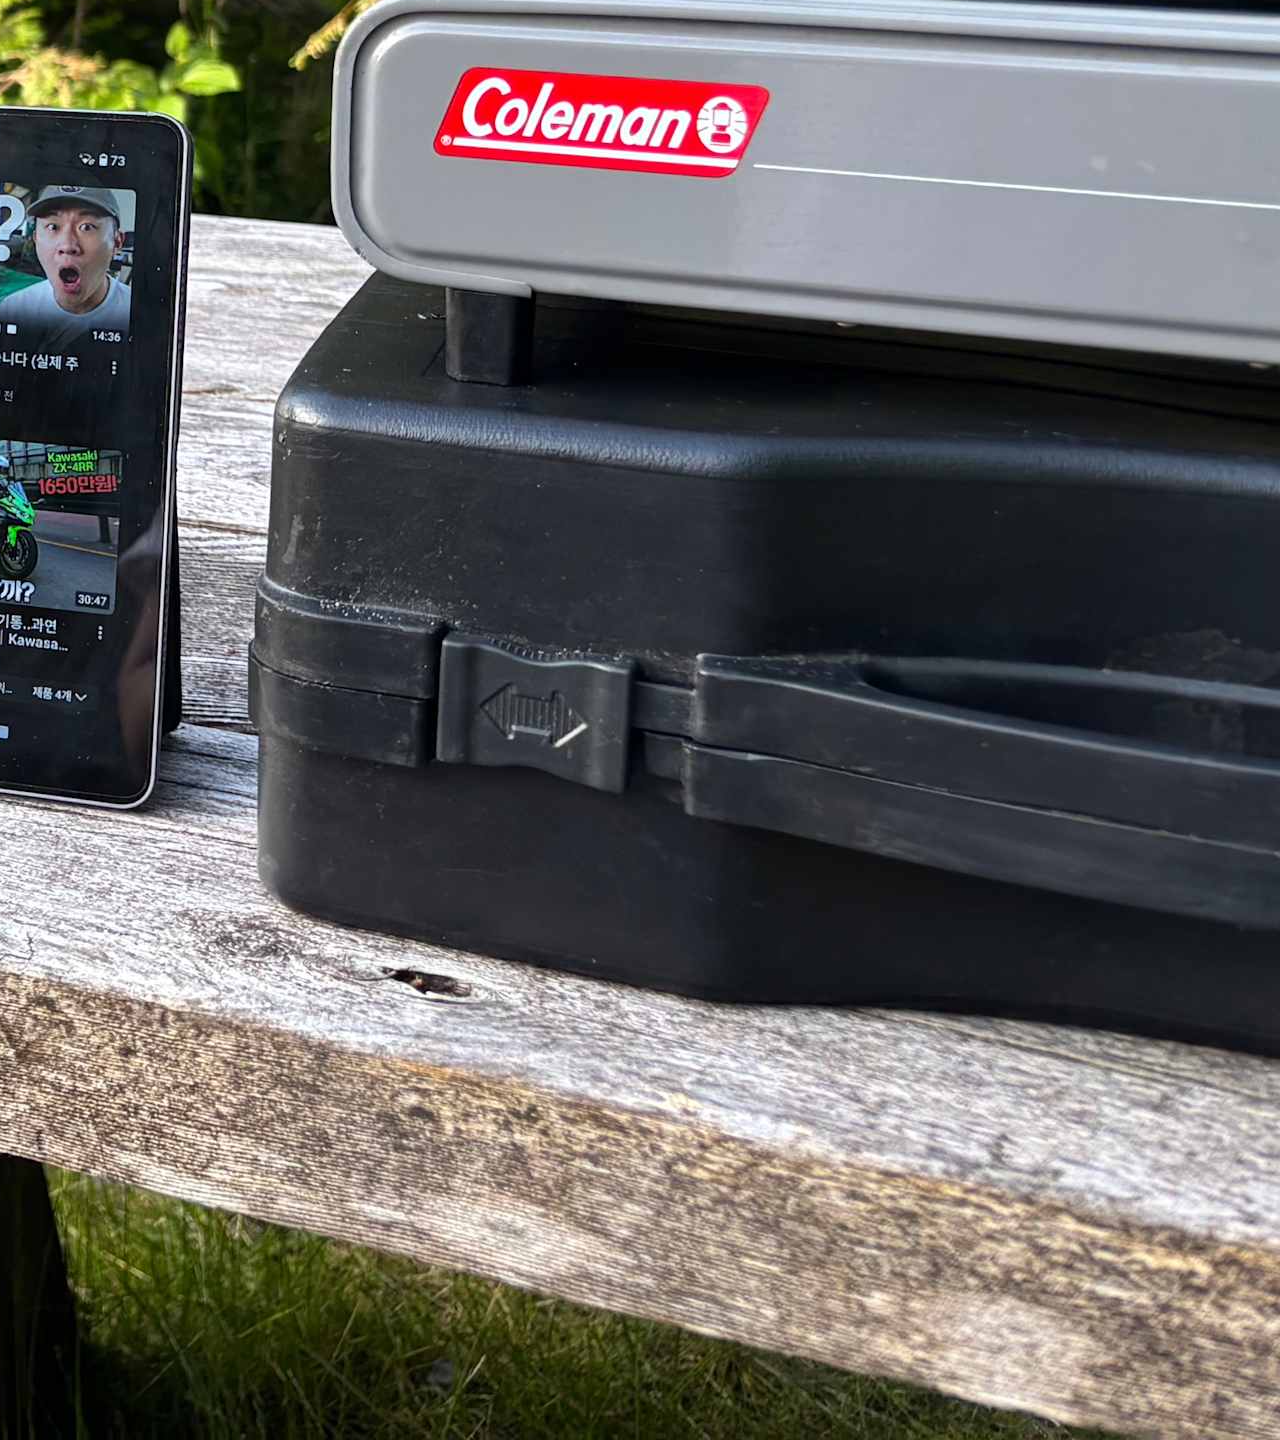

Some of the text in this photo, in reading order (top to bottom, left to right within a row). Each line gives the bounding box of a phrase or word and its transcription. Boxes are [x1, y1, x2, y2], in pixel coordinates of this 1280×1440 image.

[462, 76, 691, 149] Coleman
[110, 155, 126, 166] 73
[92, 331, 121, 342] 14:36
[31, 354, 62, 370] (실제
[65, 357, 79, 371] 주
[4, 390, 14, 402] 전
[47, 450, 98, 462] Kawasaki
[53, 462, 94, 473] ZX-4RR
[38, 475, 117, 495] 1650만원!
[77, 594, 107, 606] 30:47
[8, 633, 69, 652] Kawasa...
[33, 686, 72, 702] 제품 4개
